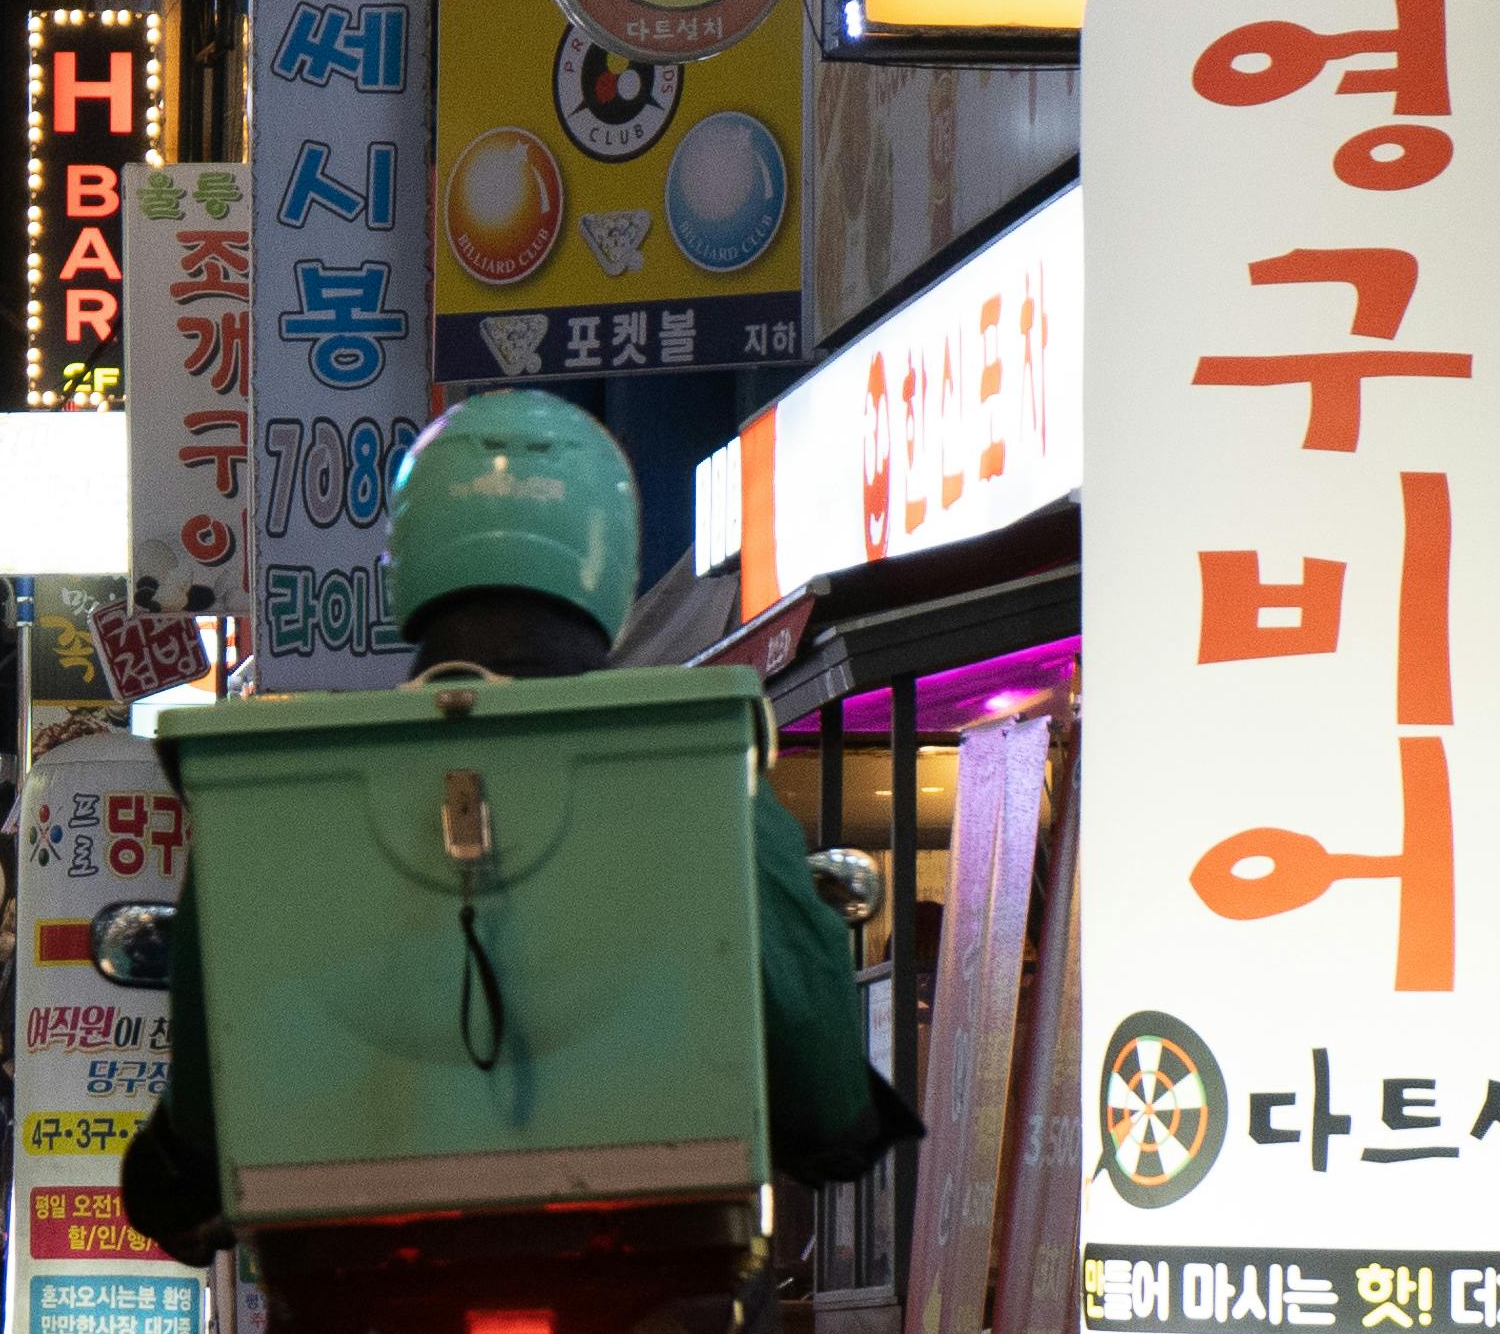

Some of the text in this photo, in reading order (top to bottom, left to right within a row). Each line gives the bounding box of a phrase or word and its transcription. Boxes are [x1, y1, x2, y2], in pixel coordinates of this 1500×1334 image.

[625, 17, 726, 43] 다트설치
[53, 51, 134, 135] H
[136, 173, 243, 220] 울릉
[60, 165, 122, 344] BAR
[564, 310, 700, 371] 포켓볼
[35, 1195, 67, 1222] 평일
[41, 1285, 157, 1311] 혼자오시는분
[1180, 1262, 1340, 1329] 마시는
[1355, 1263, 1436, 1329] 핫!
